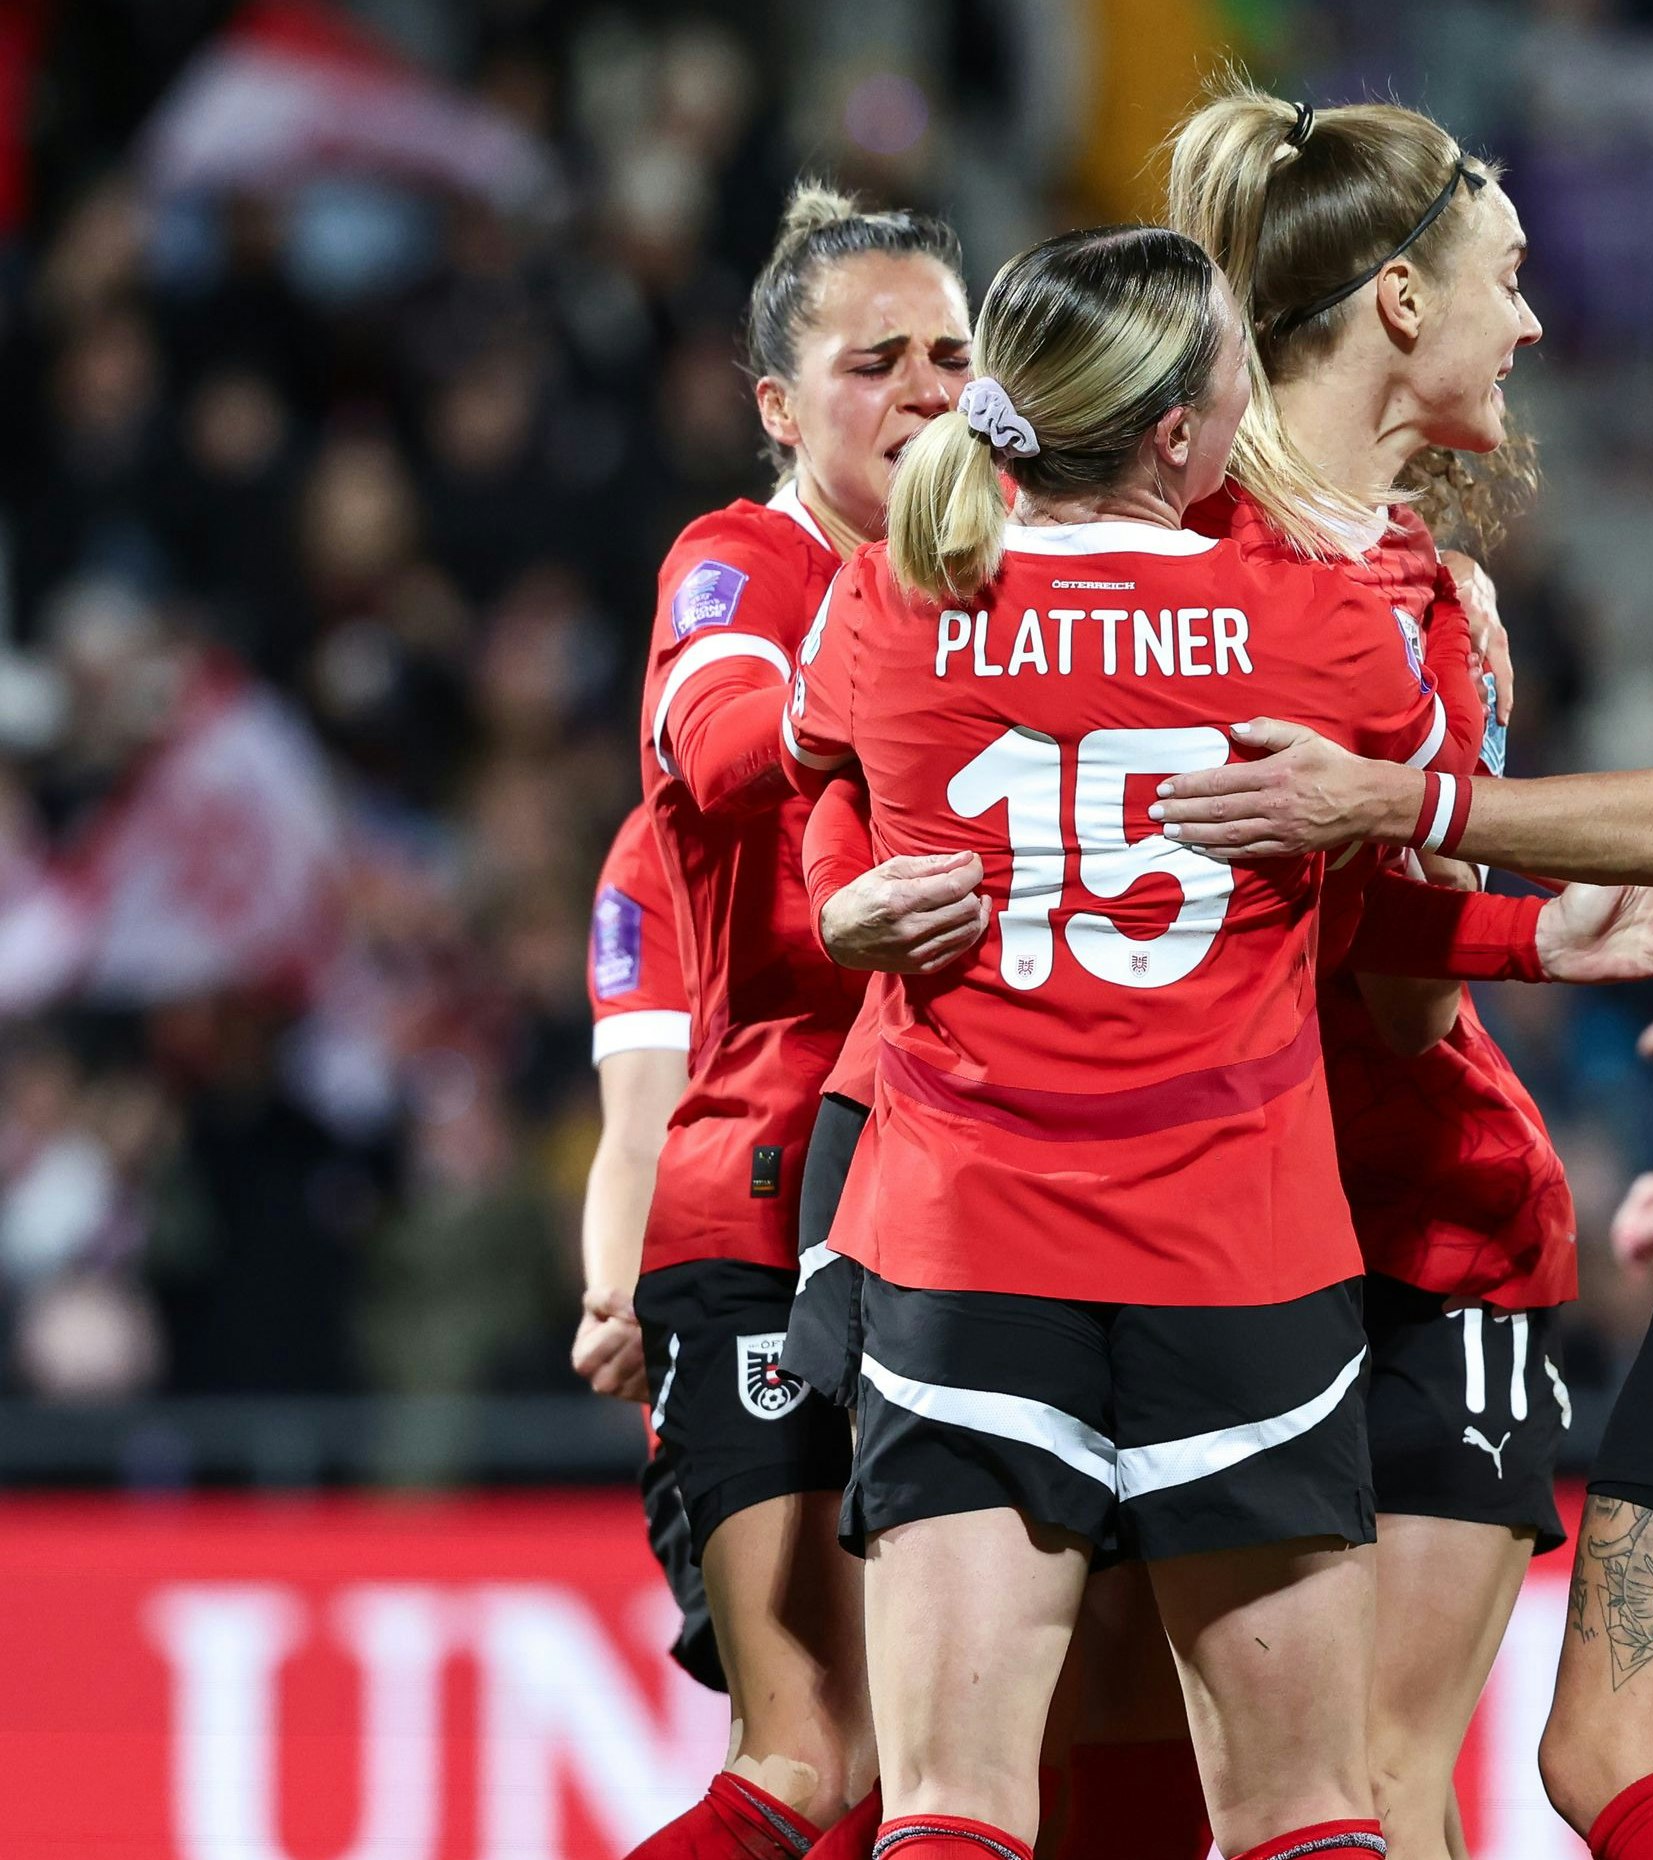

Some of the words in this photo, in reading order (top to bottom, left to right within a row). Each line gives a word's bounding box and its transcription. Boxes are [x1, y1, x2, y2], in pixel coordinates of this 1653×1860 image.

[1051, 579, 1135, 590] ÖSTERREICH
[935, 607, 1253, 677] PLATTNER
[946, 726, 1234, 991] 15
